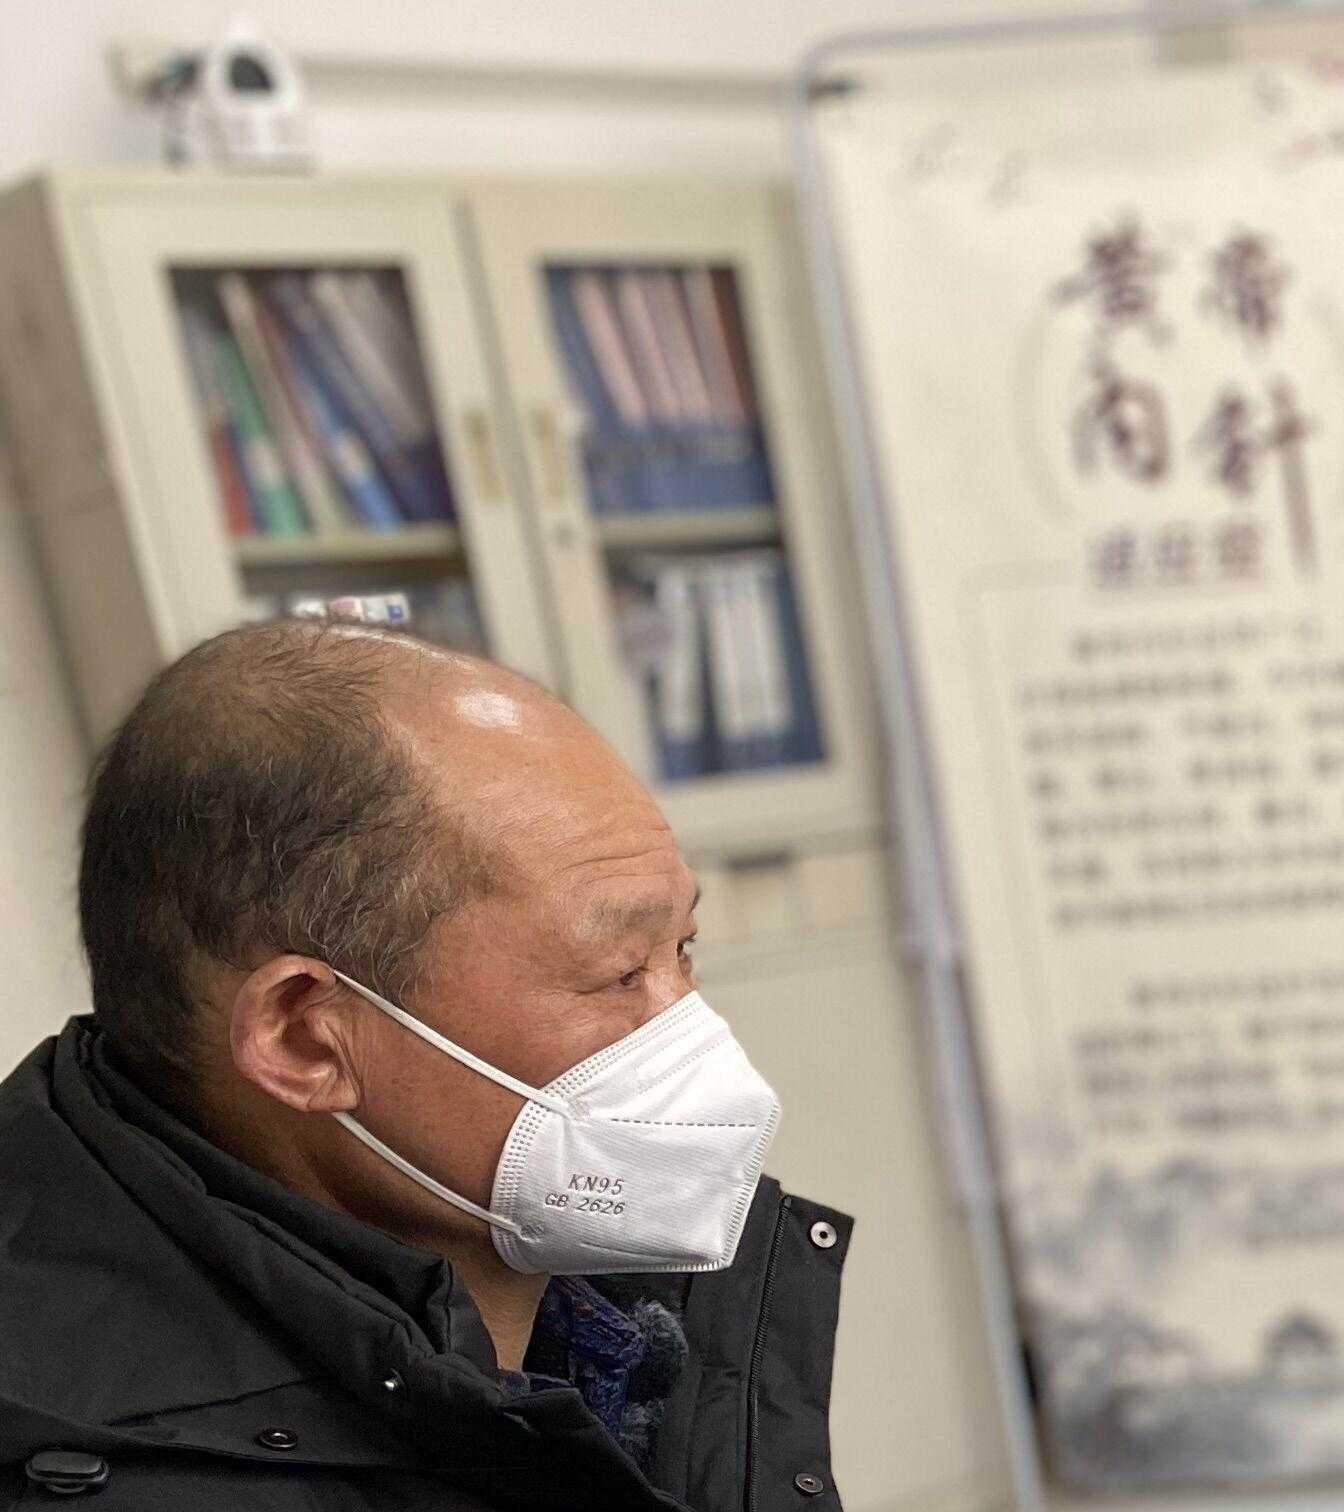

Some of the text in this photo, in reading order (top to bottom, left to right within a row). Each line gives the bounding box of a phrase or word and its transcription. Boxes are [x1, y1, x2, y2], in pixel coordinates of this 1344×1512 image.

[567, 1174, 625, 1196] KN95
[544, 1193, 626, 1215] GB 2626
